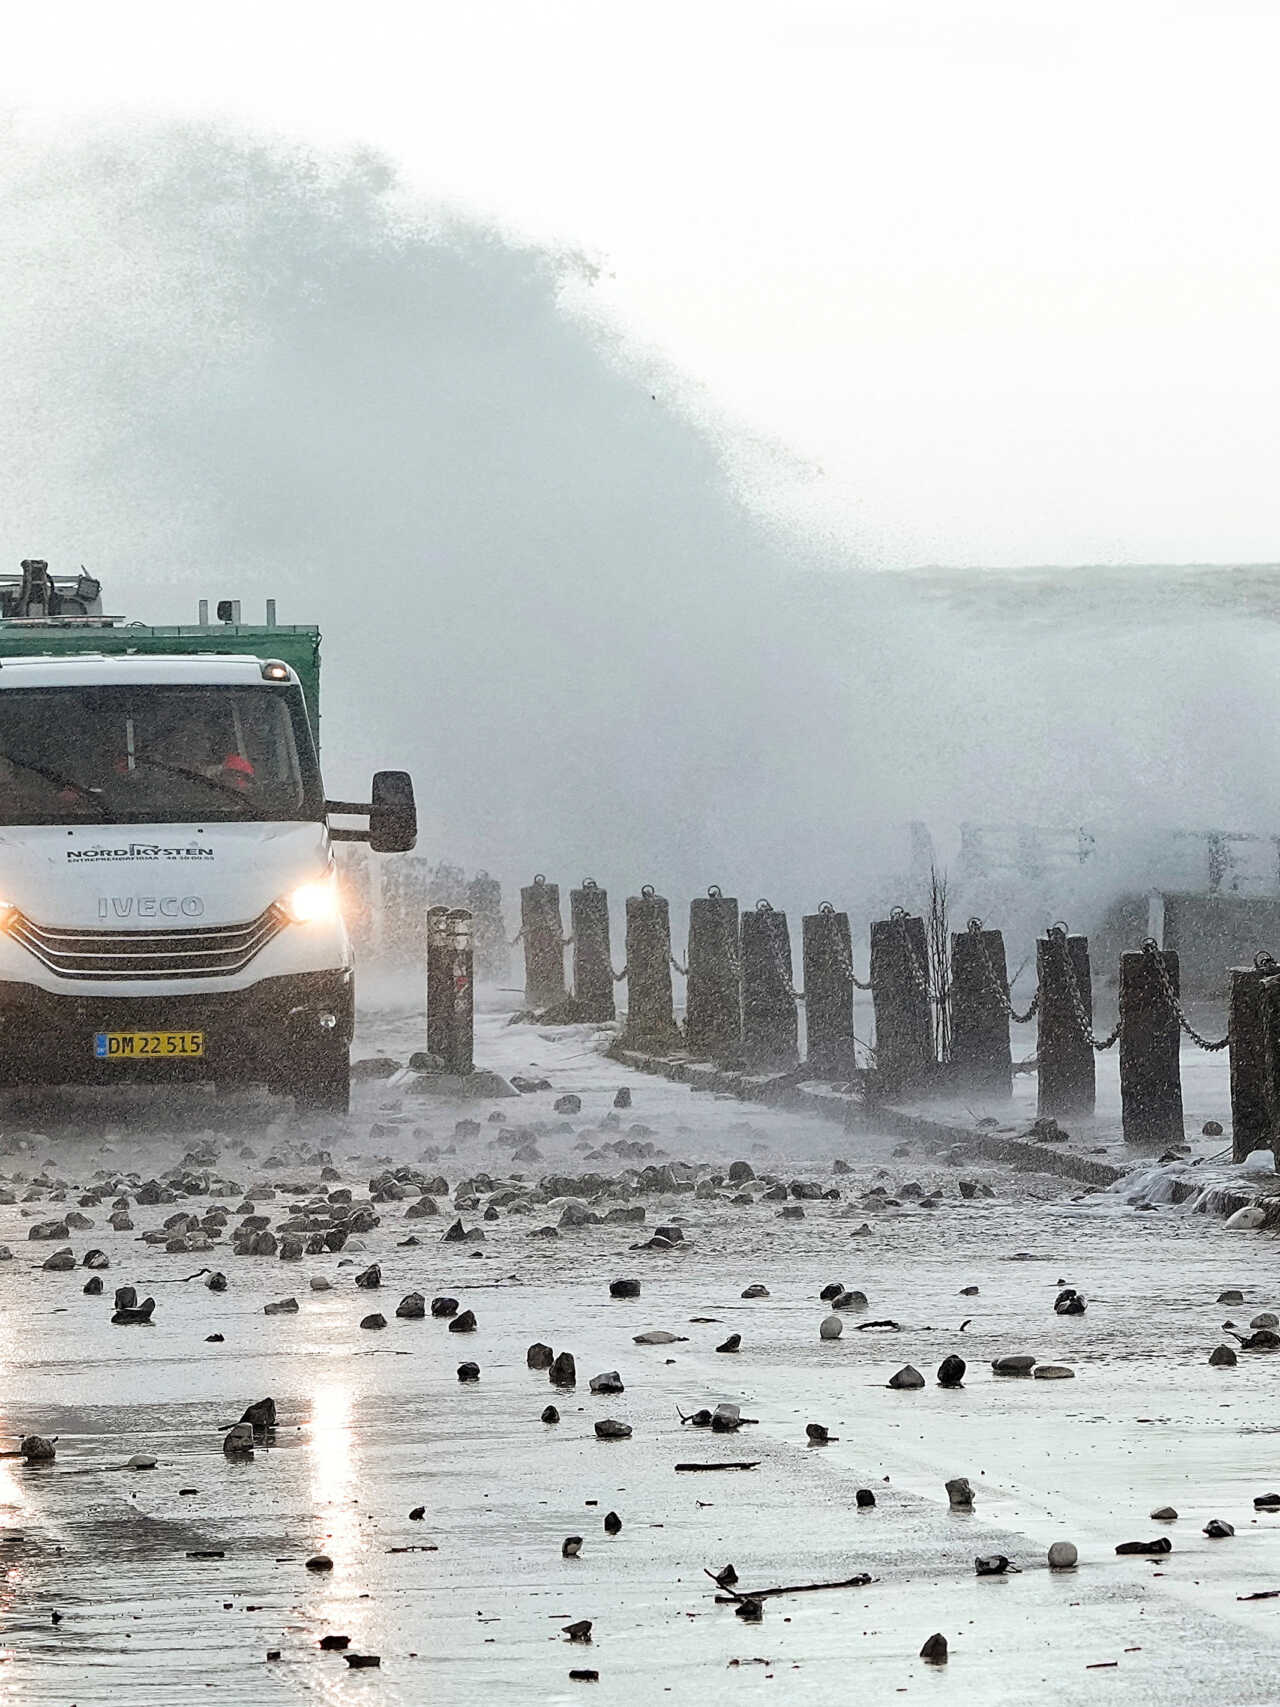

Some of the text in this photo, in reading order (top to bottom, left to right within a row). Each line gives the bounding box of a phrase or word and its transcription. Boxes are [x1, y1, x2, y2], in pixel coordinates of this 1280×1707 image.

[98, 896, 205, 918] IVECO
[108, 1036, 134, 1054] DM
[139, 1037, 161, 1054] 22
[167, 1036, 200, 1053] 515
